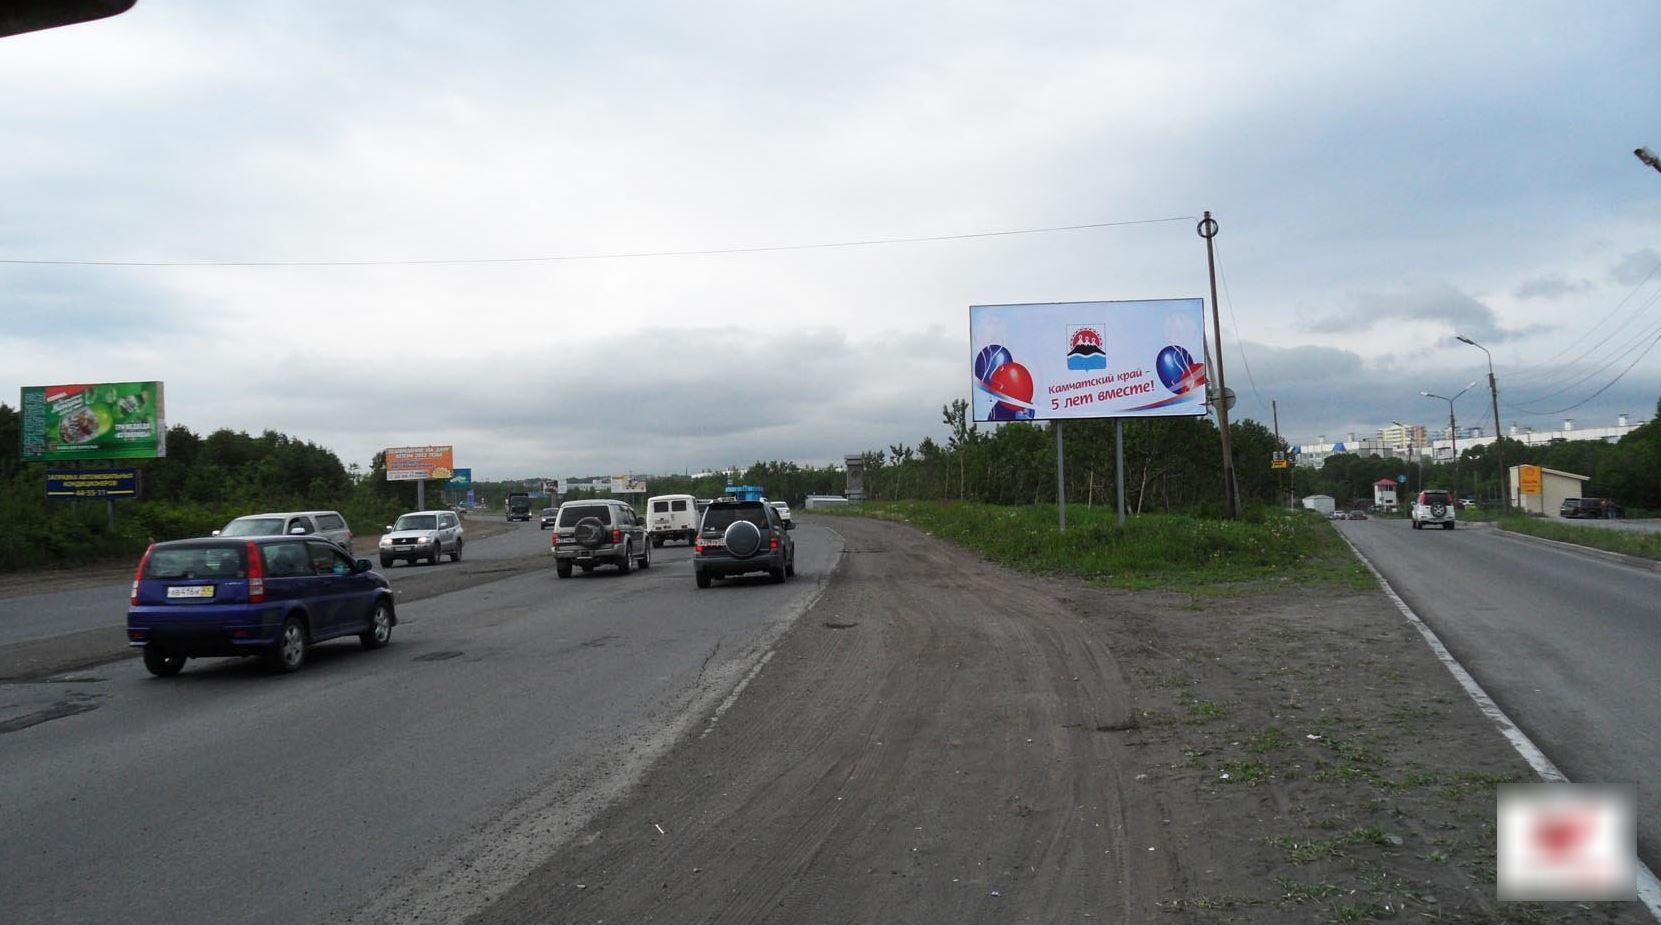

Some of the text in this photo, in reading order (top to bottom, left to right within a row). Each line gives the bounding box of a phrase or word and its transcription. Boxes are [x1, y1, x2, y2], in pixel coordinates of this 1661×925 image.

[1048, 374, 1114, 395] Камчатский
[1117, 368, 1143, 383] край
[1051, 380, 1155, 410] 5 лет вместе!
